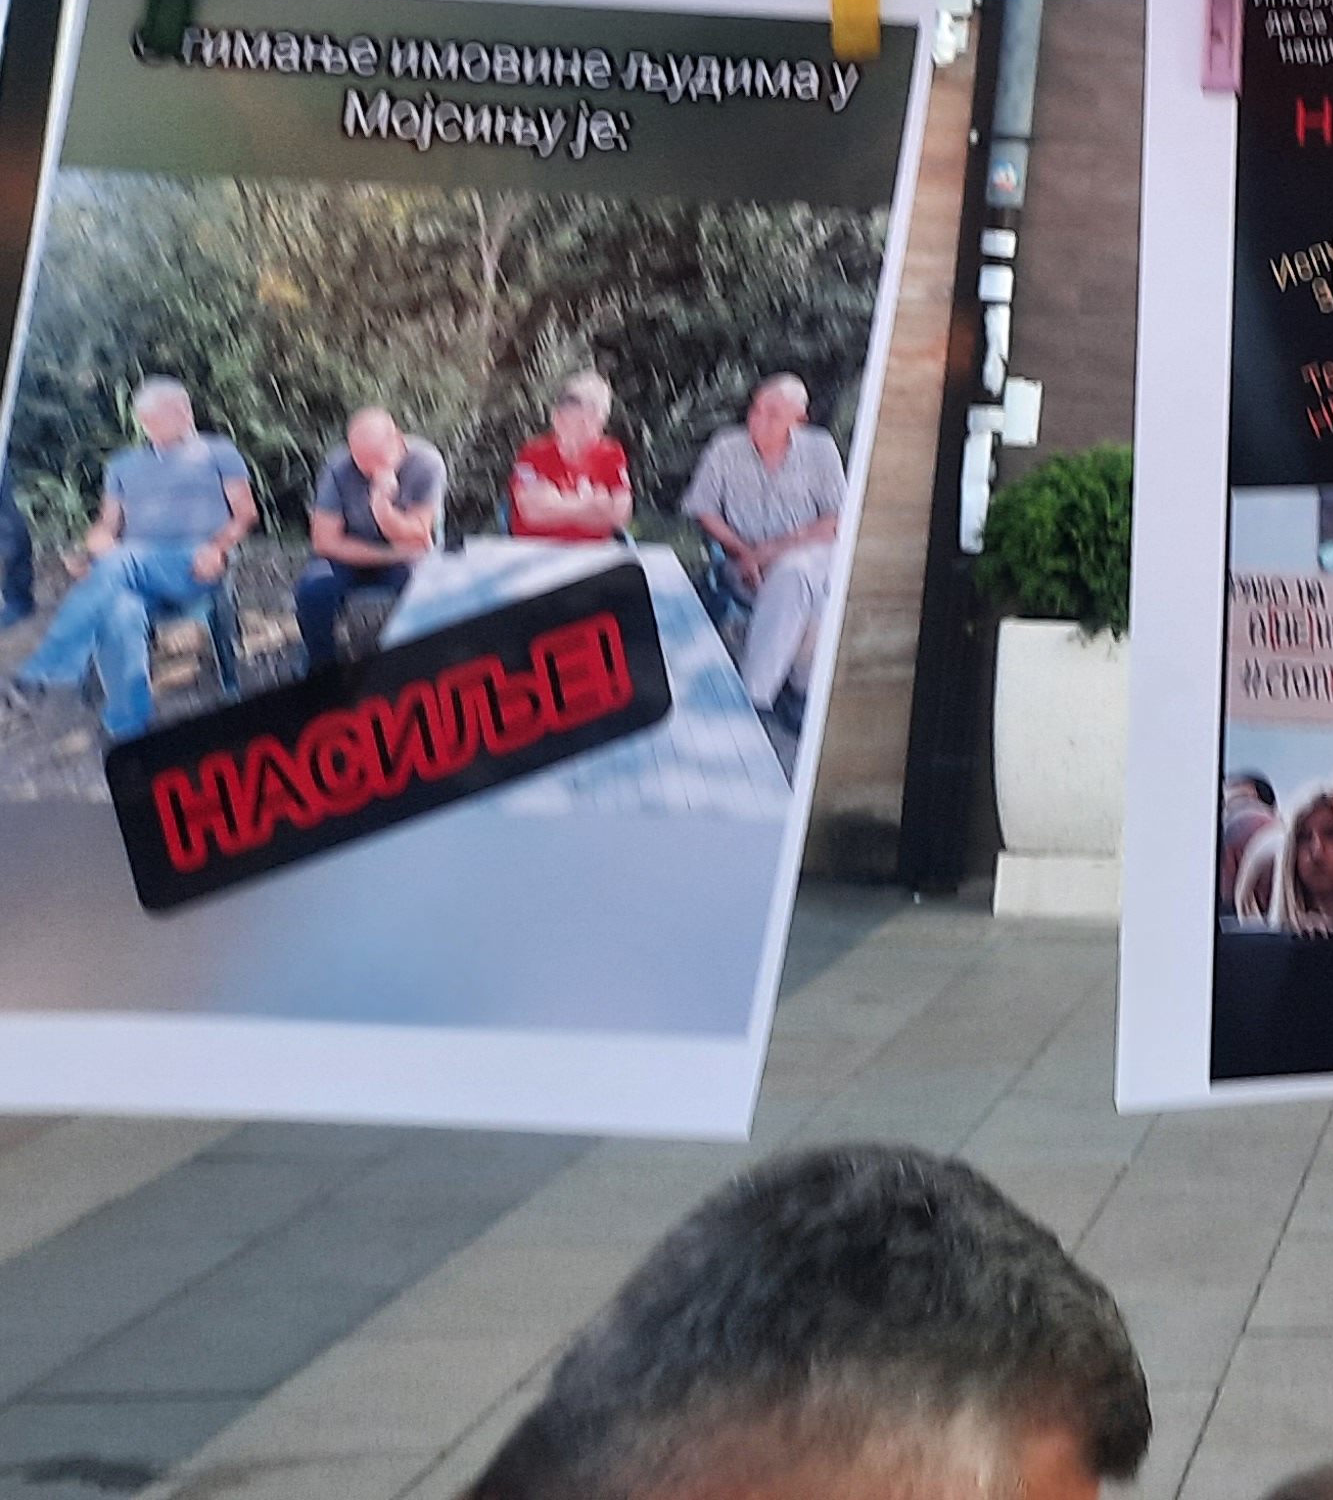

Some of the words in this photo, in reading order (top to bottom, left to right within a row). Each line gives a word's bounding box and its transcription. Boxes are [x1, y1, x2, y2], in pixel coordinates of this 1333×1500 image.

[131, 25, 379, 77] тимање
[390, 36, 614, 90] имовине
[618, 48, 820, 105] људима
[827, 59, 862, 114] у
[341, 86, 568, 160] Мојсињу
[152, 610, 634, 874] НАСИЉЕ!
